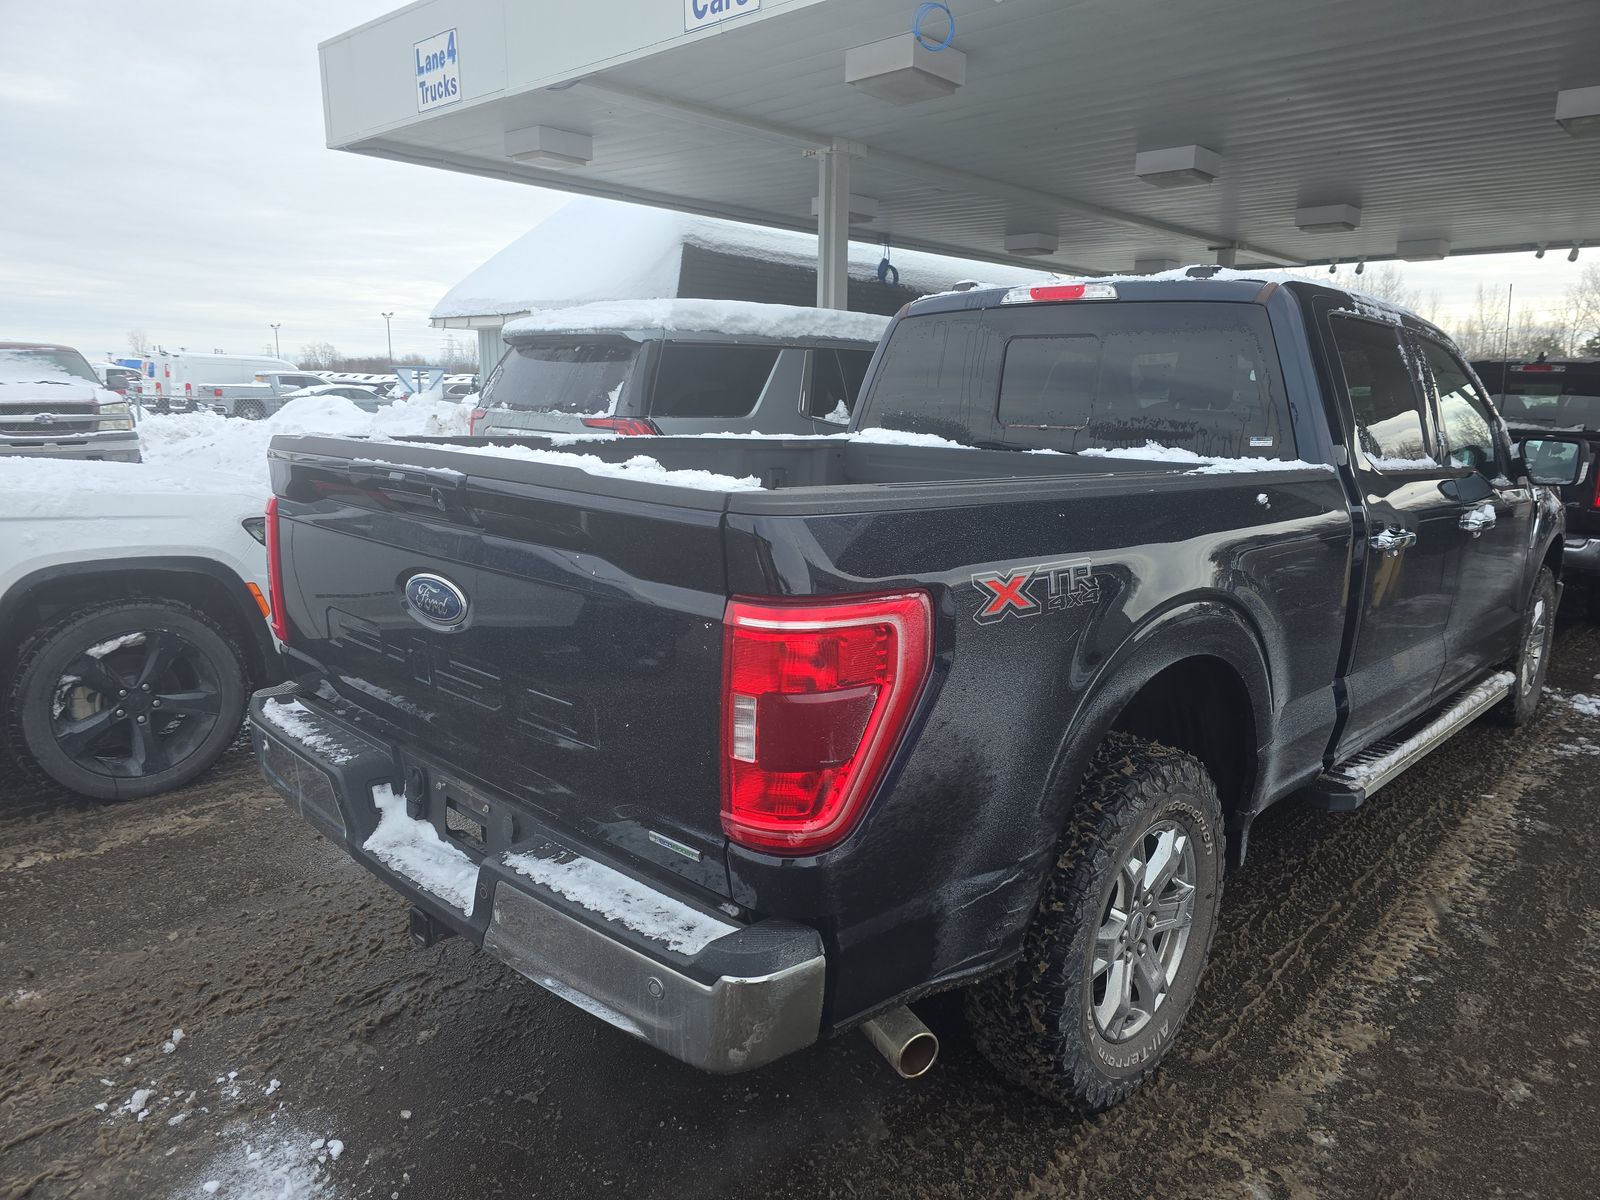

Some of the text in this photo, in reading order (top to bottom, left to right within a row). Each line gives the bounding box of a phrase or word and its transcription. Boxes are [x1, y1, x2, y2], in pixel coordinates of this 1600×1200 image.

[692, 0, 748, 20] Ca
[416, 31, 457, 76] Lane 4
[419, 74, 457, 105] Trucks
[415, 582, 450, 617] Ford
[1098, 1019, 1169, 1068] All-Terrain
